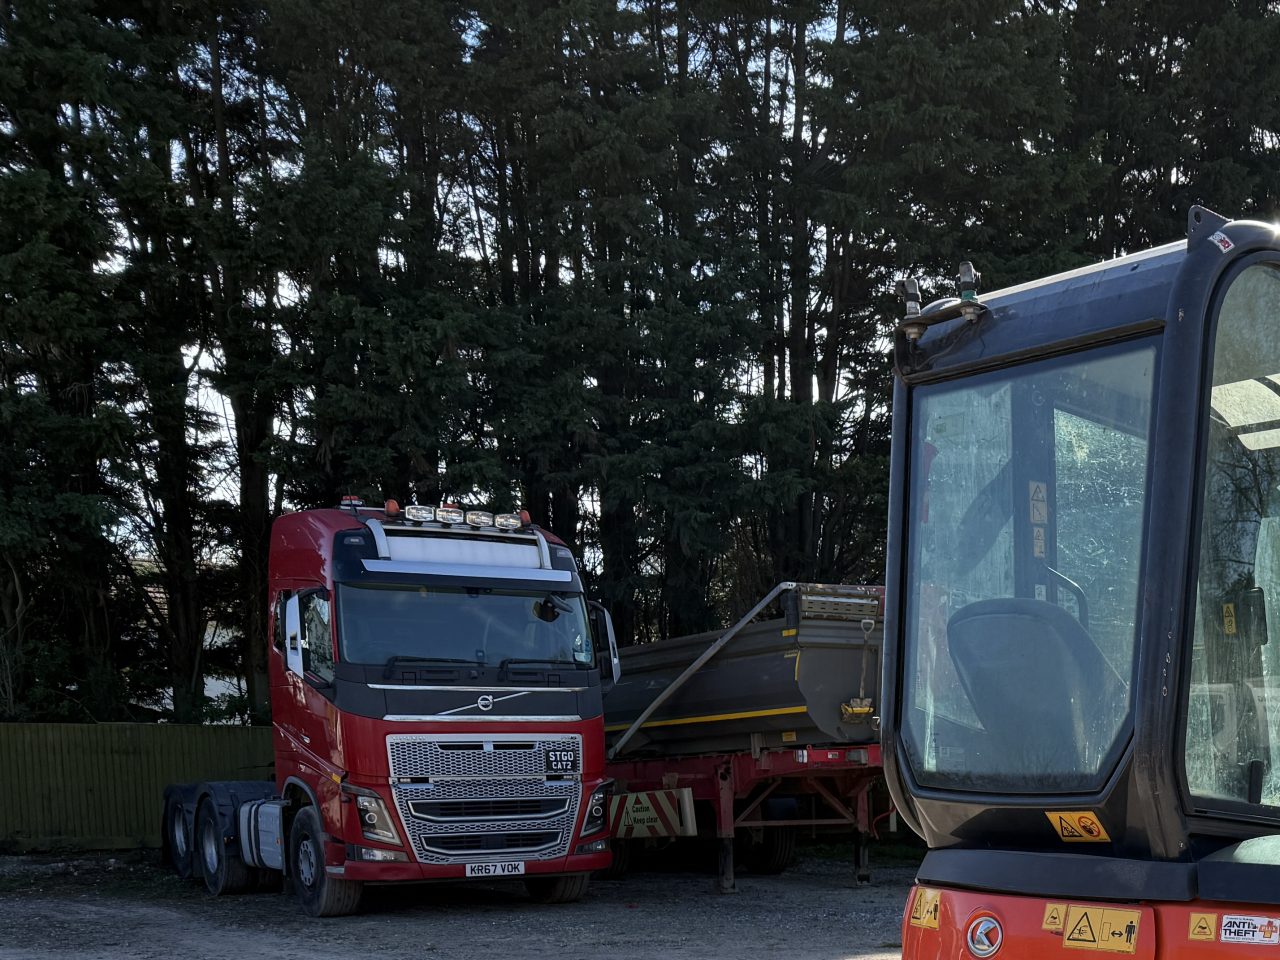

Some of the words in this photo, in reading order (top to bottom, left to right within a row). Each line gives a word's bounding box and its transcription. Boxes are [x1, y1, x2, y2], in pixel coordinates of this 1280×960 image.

[549, 751, 574, 761] STGO
[632, 805, 650, 813] Caution
[633, 816, 645, 825] Keep
[646, 815, 659, 824] clear
[470, 864, 497, 875] KR67
[500, 863, 521, 873] VOK
[1223, 920, 1251, 929] ANTI
[1223, 929, 1257, 938] THEFT
